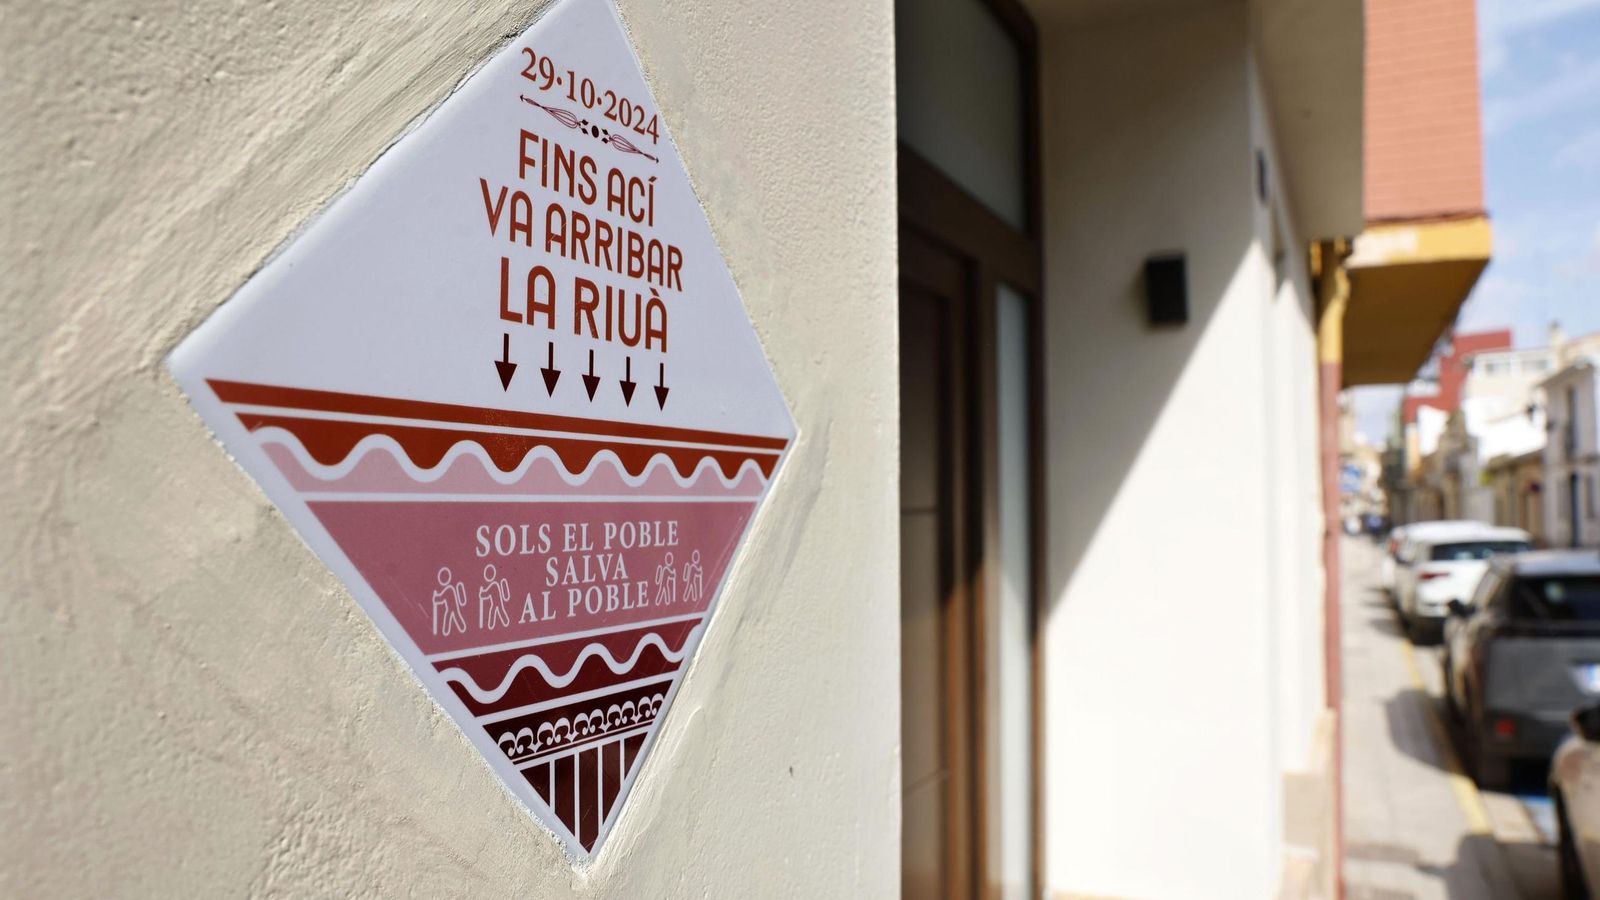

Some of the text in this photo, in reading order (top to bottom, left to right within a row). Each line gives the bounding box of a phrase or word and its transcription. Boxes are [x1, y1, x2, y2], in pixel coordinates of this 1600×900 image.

[519, 128, 658, 227] FINS ACÍ
[479, 177, 683, 292] VA ARRIBAR
[500, 256, 668, 353] LA RIUÀ
[475, 520, 679, 557] SOLS EL POBLE
[545, 552, 629, 587] SALVA
[518, 581, 649, 624] AL POBLE
